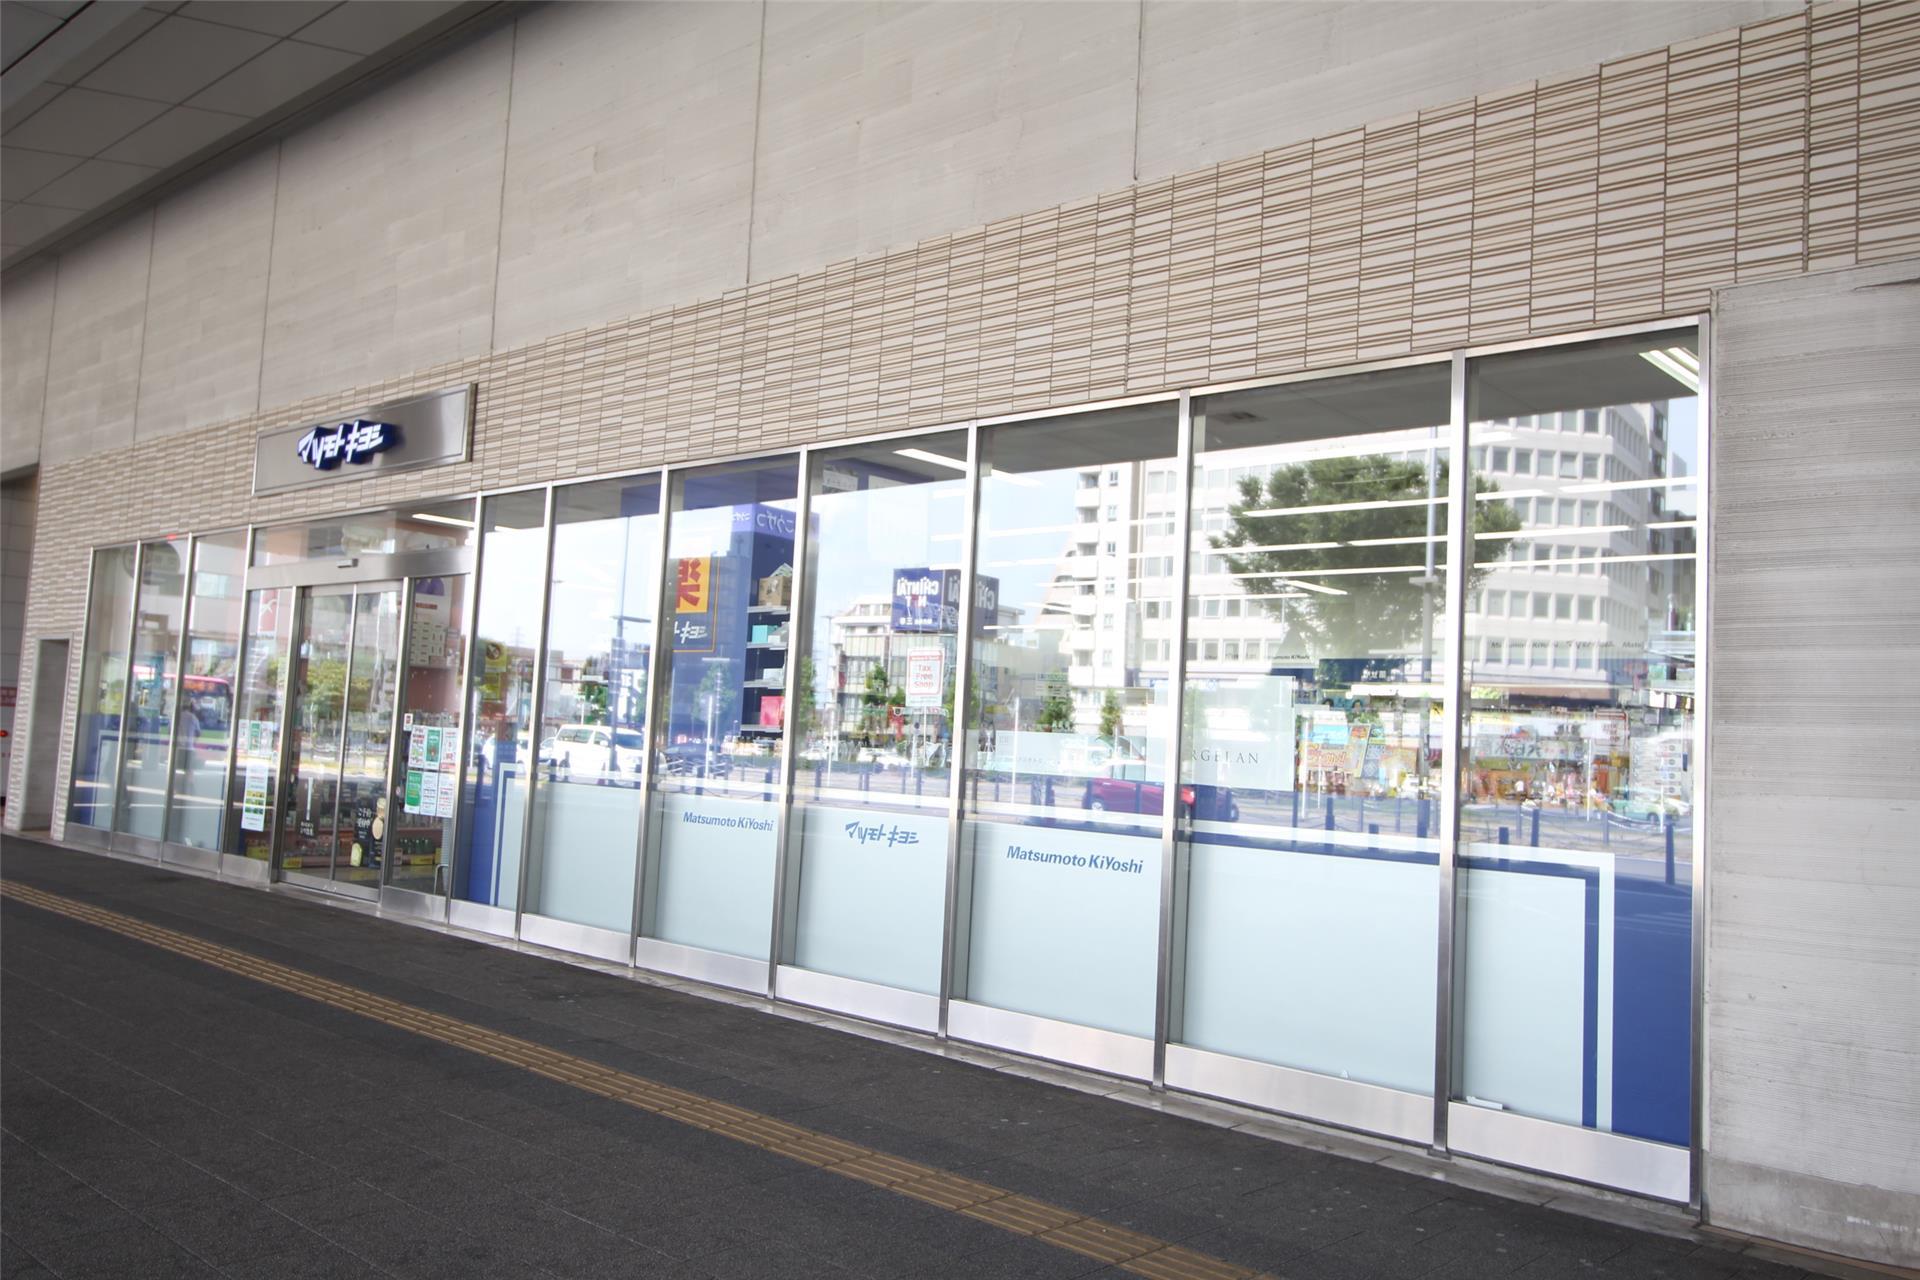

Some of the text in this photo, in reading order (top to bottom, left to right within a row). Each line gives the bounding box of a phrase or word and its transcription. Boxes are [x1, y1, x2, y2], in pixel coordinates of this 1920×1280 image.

[299, 420, 384, 469] マツモトキヨシ
[683, 812, 774, 832] Matsumoto KiYoshi
[845, 821, 919, 847] マツモトキヨシ
[1006, 846, 1143, 874] Matsumoto KiYoshi
